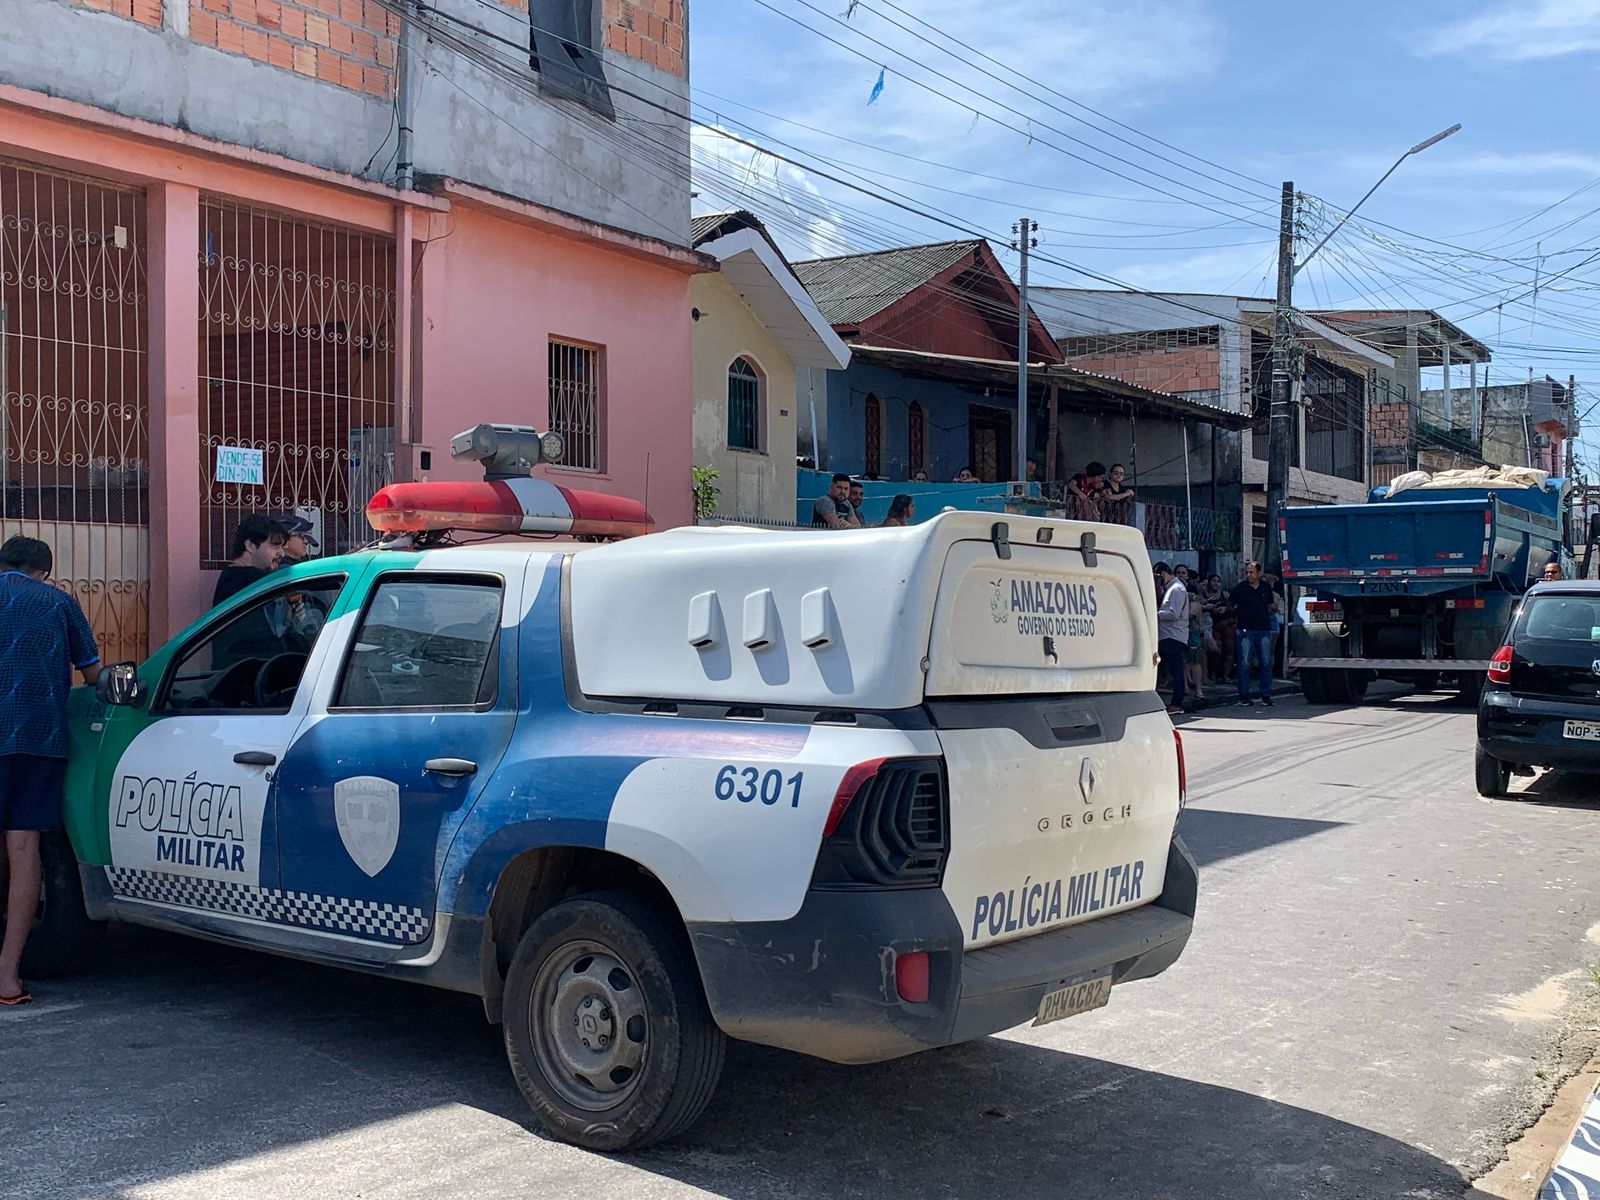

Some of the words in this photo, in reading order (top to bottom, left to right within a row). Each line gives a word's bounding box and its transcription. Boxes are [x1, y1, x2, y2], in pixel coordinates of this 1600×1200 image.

[218, 450, 262, 467] VENDE-SE
[218, 465, 258, 483] DIN-DIN
[1011, 579, 1098, 617] AMAZONAS
[1017, 615, 1055, 636] GOVERNO
[1056, 618, 1067, 636] DO
[1068, 618, 1096, 638] ESTADO
[714, 764, 804, 808] 6301
[115, 769, 244, 842] POLÍCIA
[1037, 804, 1132, 832] OROCH
[156, 835, 246, 873] MILITAR
[972, 875, 1062, 940] POLÍCIA
[1065, 860, 1144, 918] MILITAR
